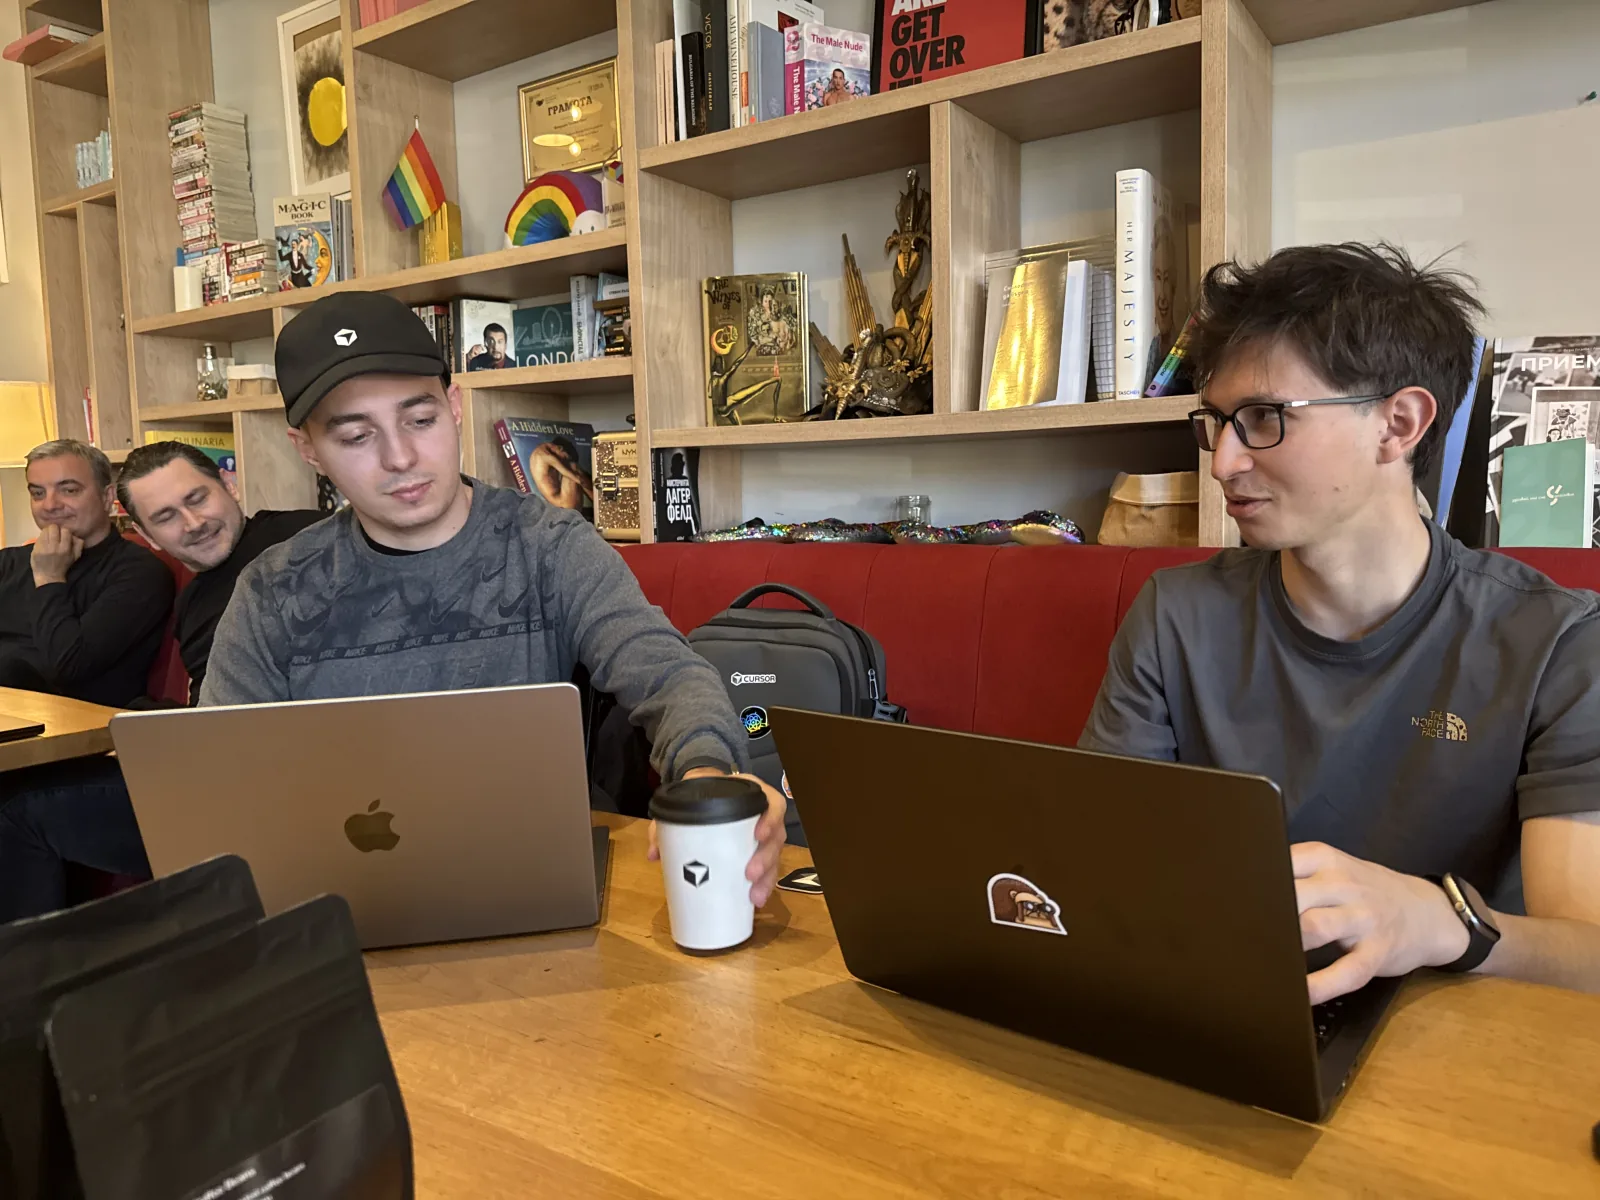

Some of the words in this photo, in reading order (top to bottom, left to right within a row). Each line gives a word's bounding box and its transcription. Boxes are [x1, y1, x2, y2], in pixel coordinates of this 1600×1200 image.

[704, 13, 712, 49] VICTOR
[729, 14, 737, 33] AMY
[891, 5, 945, 46] GET
[811, 33, 825, 45] The
[825, 36, 843, 49] Male
[844, 41, 863, 52] Nude
[889, 35, 965, 79] OVER
[730, 35, 739, 100] WINEHOUSE
[792, 66, 800, 82] The
[793, 83, 801, 106] Male
[547, 95, 593, 117] ГРАМОТА
[290, 211, 314, 220] BOOK
[704, 289, 742, 305] WINES
[1121, 250, 1135, 361] MAJESTY
[516, 351, 575, 368] LOND
[511, 421, 519, 431] A
[519, 421, 554, 434] Hidden
[553, 424, 575, 436] Love
[512, 465, 527, 493] Hidden
[667, 504, 693, 524] ФЕЛД
[344, 647, 368, 657] NIKE
[479, 627, 500, 638] NIKE
[743, 675, 776, 683] CURSOR
[1411, 716, 1444, 730] NORTH
[1429, 710, 1444, 721] THE
[1421, 727, 1444, 739] FACE
